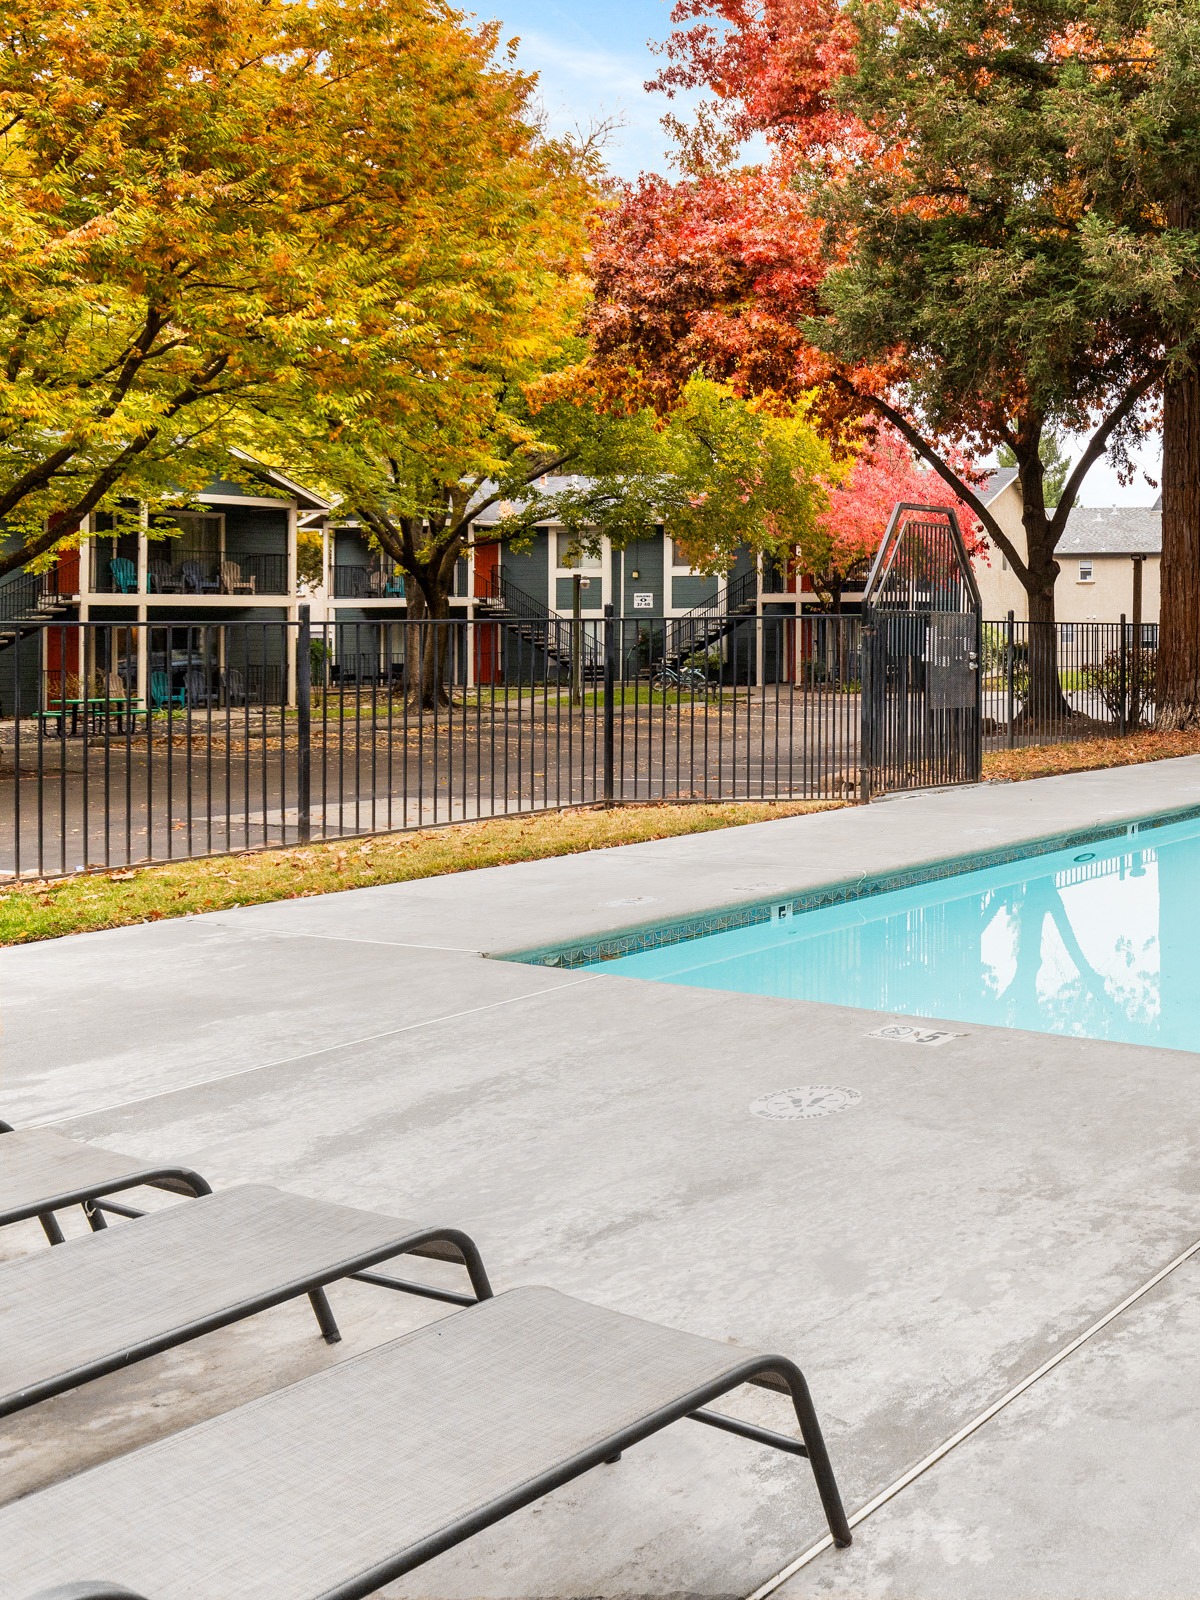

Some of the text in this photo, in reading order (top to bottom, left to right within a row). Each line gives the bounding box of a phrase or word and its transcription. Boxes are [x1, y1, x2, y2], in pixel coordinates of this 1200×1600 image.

[916, 1031, 949, 1042] 5
[758, 1087, 804, 1101] SOCIAL
[756, 1110, 823, 1119] MAINTAIN
